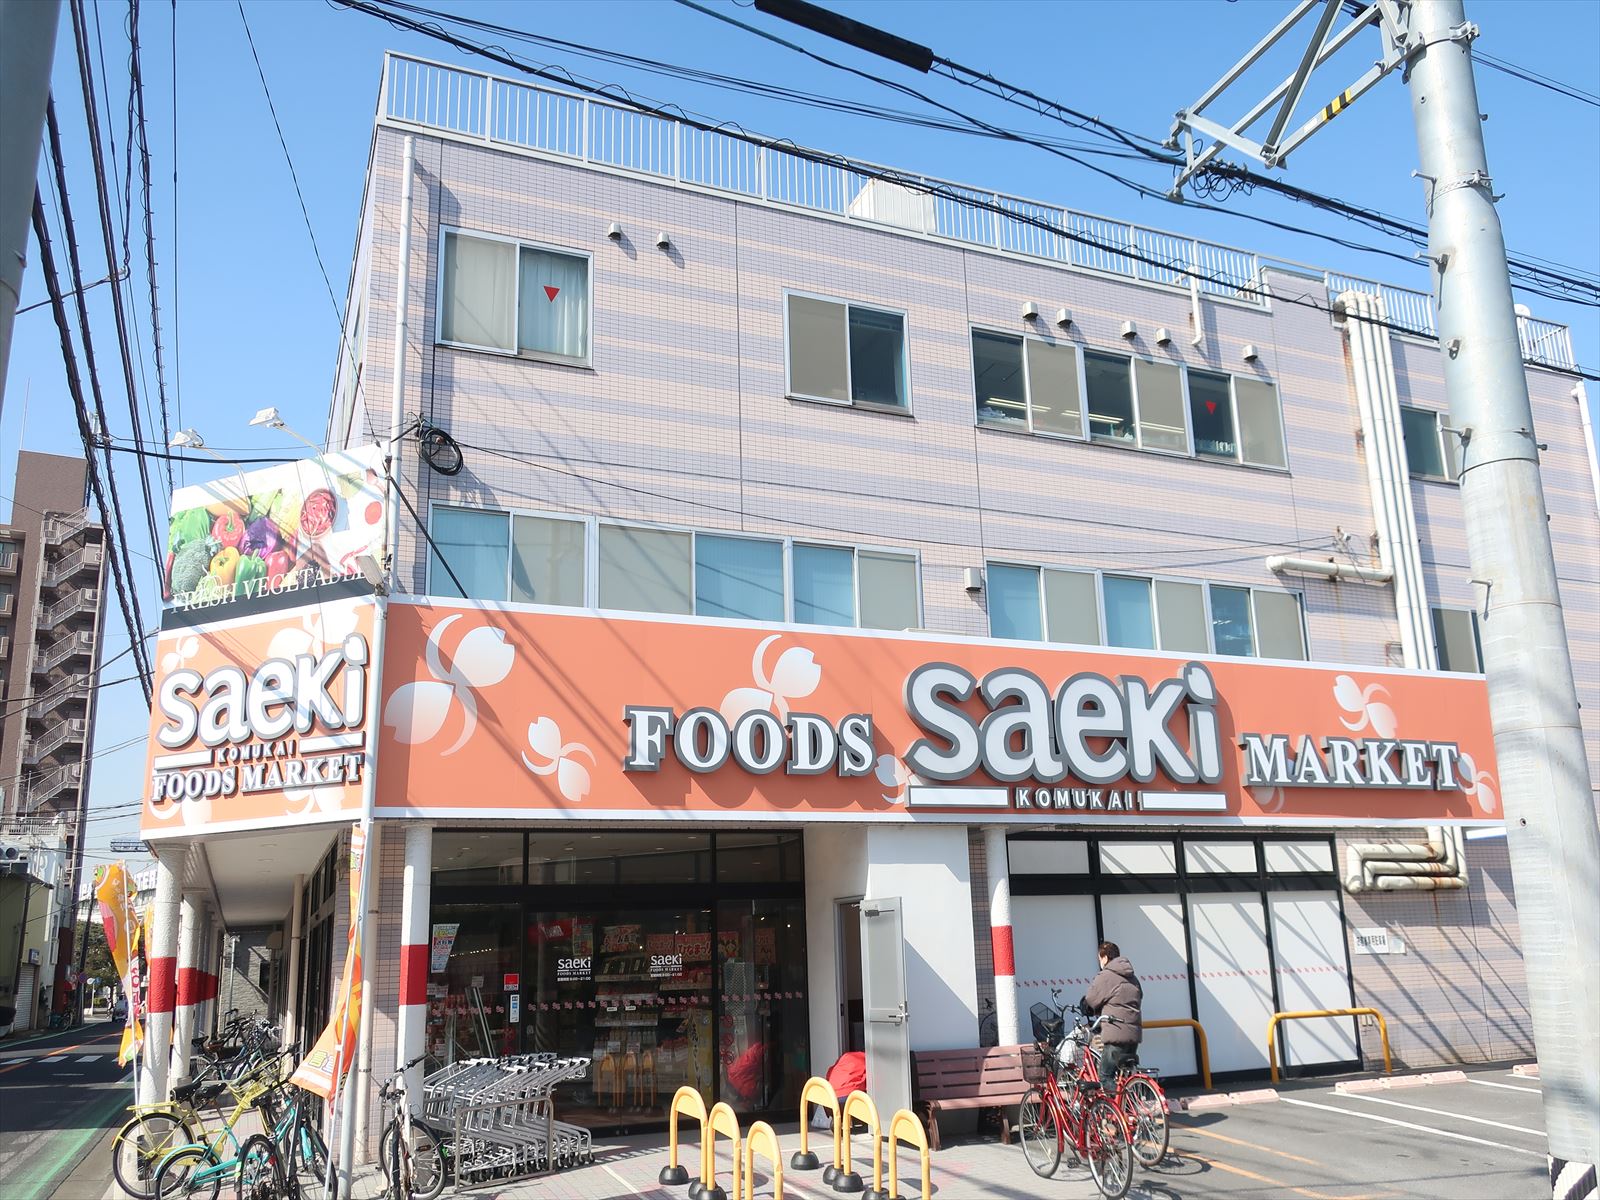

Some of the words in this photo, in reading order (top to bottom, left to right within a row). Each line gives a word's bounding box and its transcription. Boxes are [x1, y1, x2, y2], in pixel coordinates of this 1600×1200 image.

[171, 583, 237, 614] FRESH
[216, 740, 297, 765] KOMUKAI
[623, 704, 876, 777] FOODS
[1240, 733, 1462, 790] MARKET
[152, 765, 237, 803] FOODS
[240, 753, 365, 794] MARKET
[1015, 786, 1140, 811] KOMUKAI
